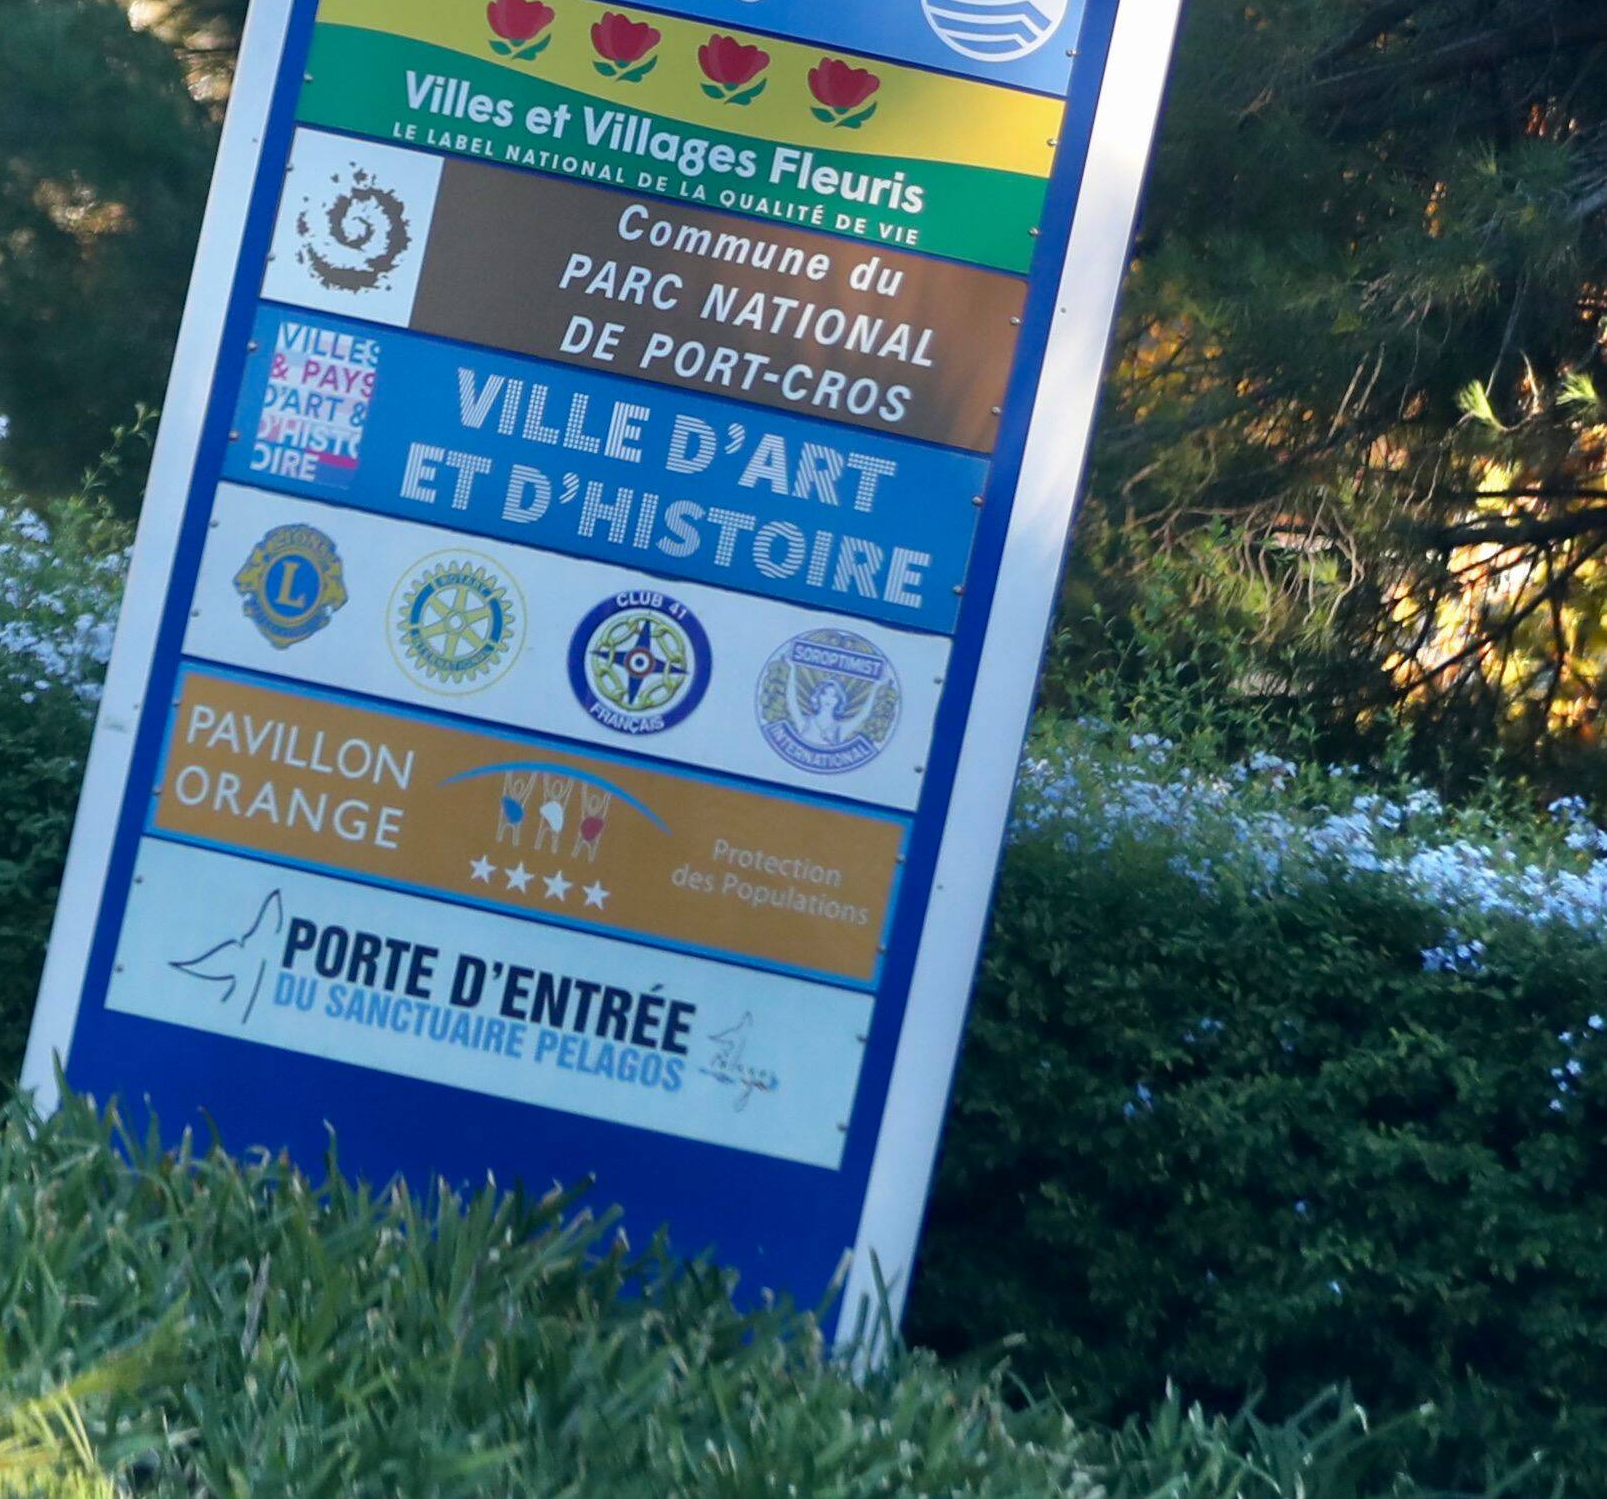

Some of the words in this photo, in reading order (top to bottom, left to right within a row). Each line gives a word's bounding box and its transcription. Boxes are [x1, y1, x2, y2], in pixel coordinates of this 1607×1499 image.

[392, 121, 418, 140] LE
[426, 128, 494, 158] LABEL
[505, 145, 626, 184] NATIONAL
[637, 172, 669, 193] DE
[679, 181, 708, 201] LA
[719, 189, 824, 226] QUALITÉ
[835, 213, 867, 235] DE
[878, 222, 920, 246] VIE
[405, 70, 515, 128] Villes
[525, 103, 571, 139] et
[583, 105, 756, 177] Villages
[770, 146, 924, 215] Fleuris
[617, 203, 831, 281] Commune
[848, 256, 904, 297] du
[558, 252, 683, 310] PARC
[699, 283, 934, 368] NATIONAL
[301, 359, 377, 399] PAYS
[559, 314, 626, 362] DE
[639, 332, 913, 423] PORT-CROS
[457, 366, 651, 464] VILLE
[665, 413, 897, 513] D'ART
[399, 441, 491, 511] ET
[501, 463, 931, 608] D'HISTOIRE
[616, 590, 664, 609] CLUB
[668, 600, 687, 620] 41
[793, 642, 885, 676] SOROPTIMIST
[187, 703, 415, 791] PAVILLON
[589, 701, 665, 734] FRANÇAIS
[769, 724, 875, 768] INTERNATIONAL
[174, 764, 404, 849] ORANGE
[671, 863, 714, 893] des
[721, 872, 869, 926] Populations
[712, 838, 842, 886] Protection
[273, 970, 317, 1012] DU
[324, 983, 528, 1060] SANCTUAIRE
[533, 1026, 686, 1093] PELAGOS
[282, 917, 439, 1000] PORTE
[448, 953, 697, 1055] D'ENTRÉE
